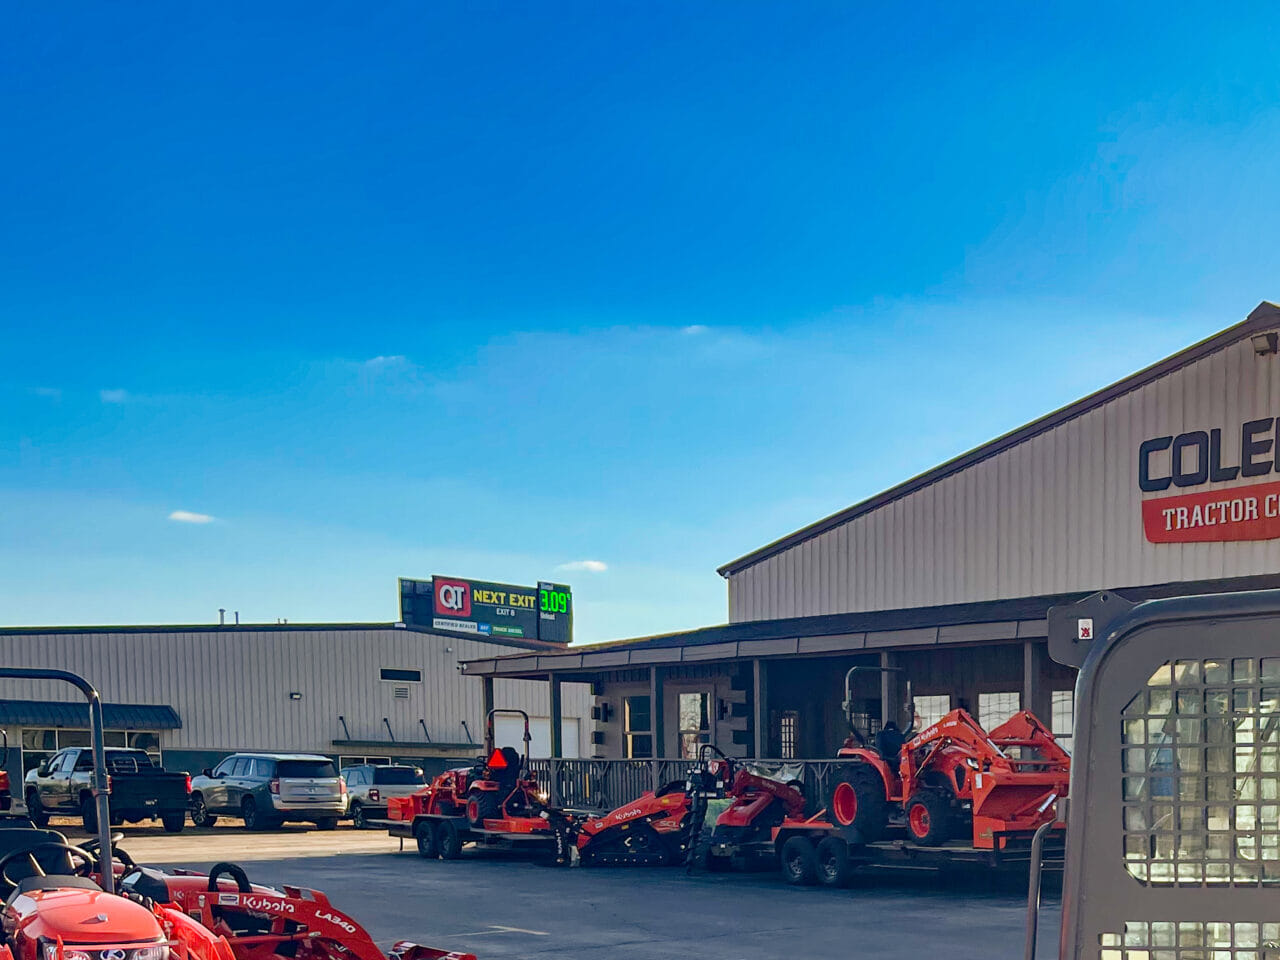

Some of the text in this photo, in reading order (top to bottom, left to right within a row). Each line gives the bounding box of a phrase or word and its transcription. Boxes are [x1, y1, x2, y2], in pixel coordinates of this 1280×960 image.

[1162, 499, 1259, 531] TRACTOR
[440, 584, 465, 610] QT
[473, 589, 536, 608] NEXT EXIT
[496, 608, 509, 616] EXIT
[243, 896, 295, 913] Kubota
[315, 909, 356, 934] LA340
